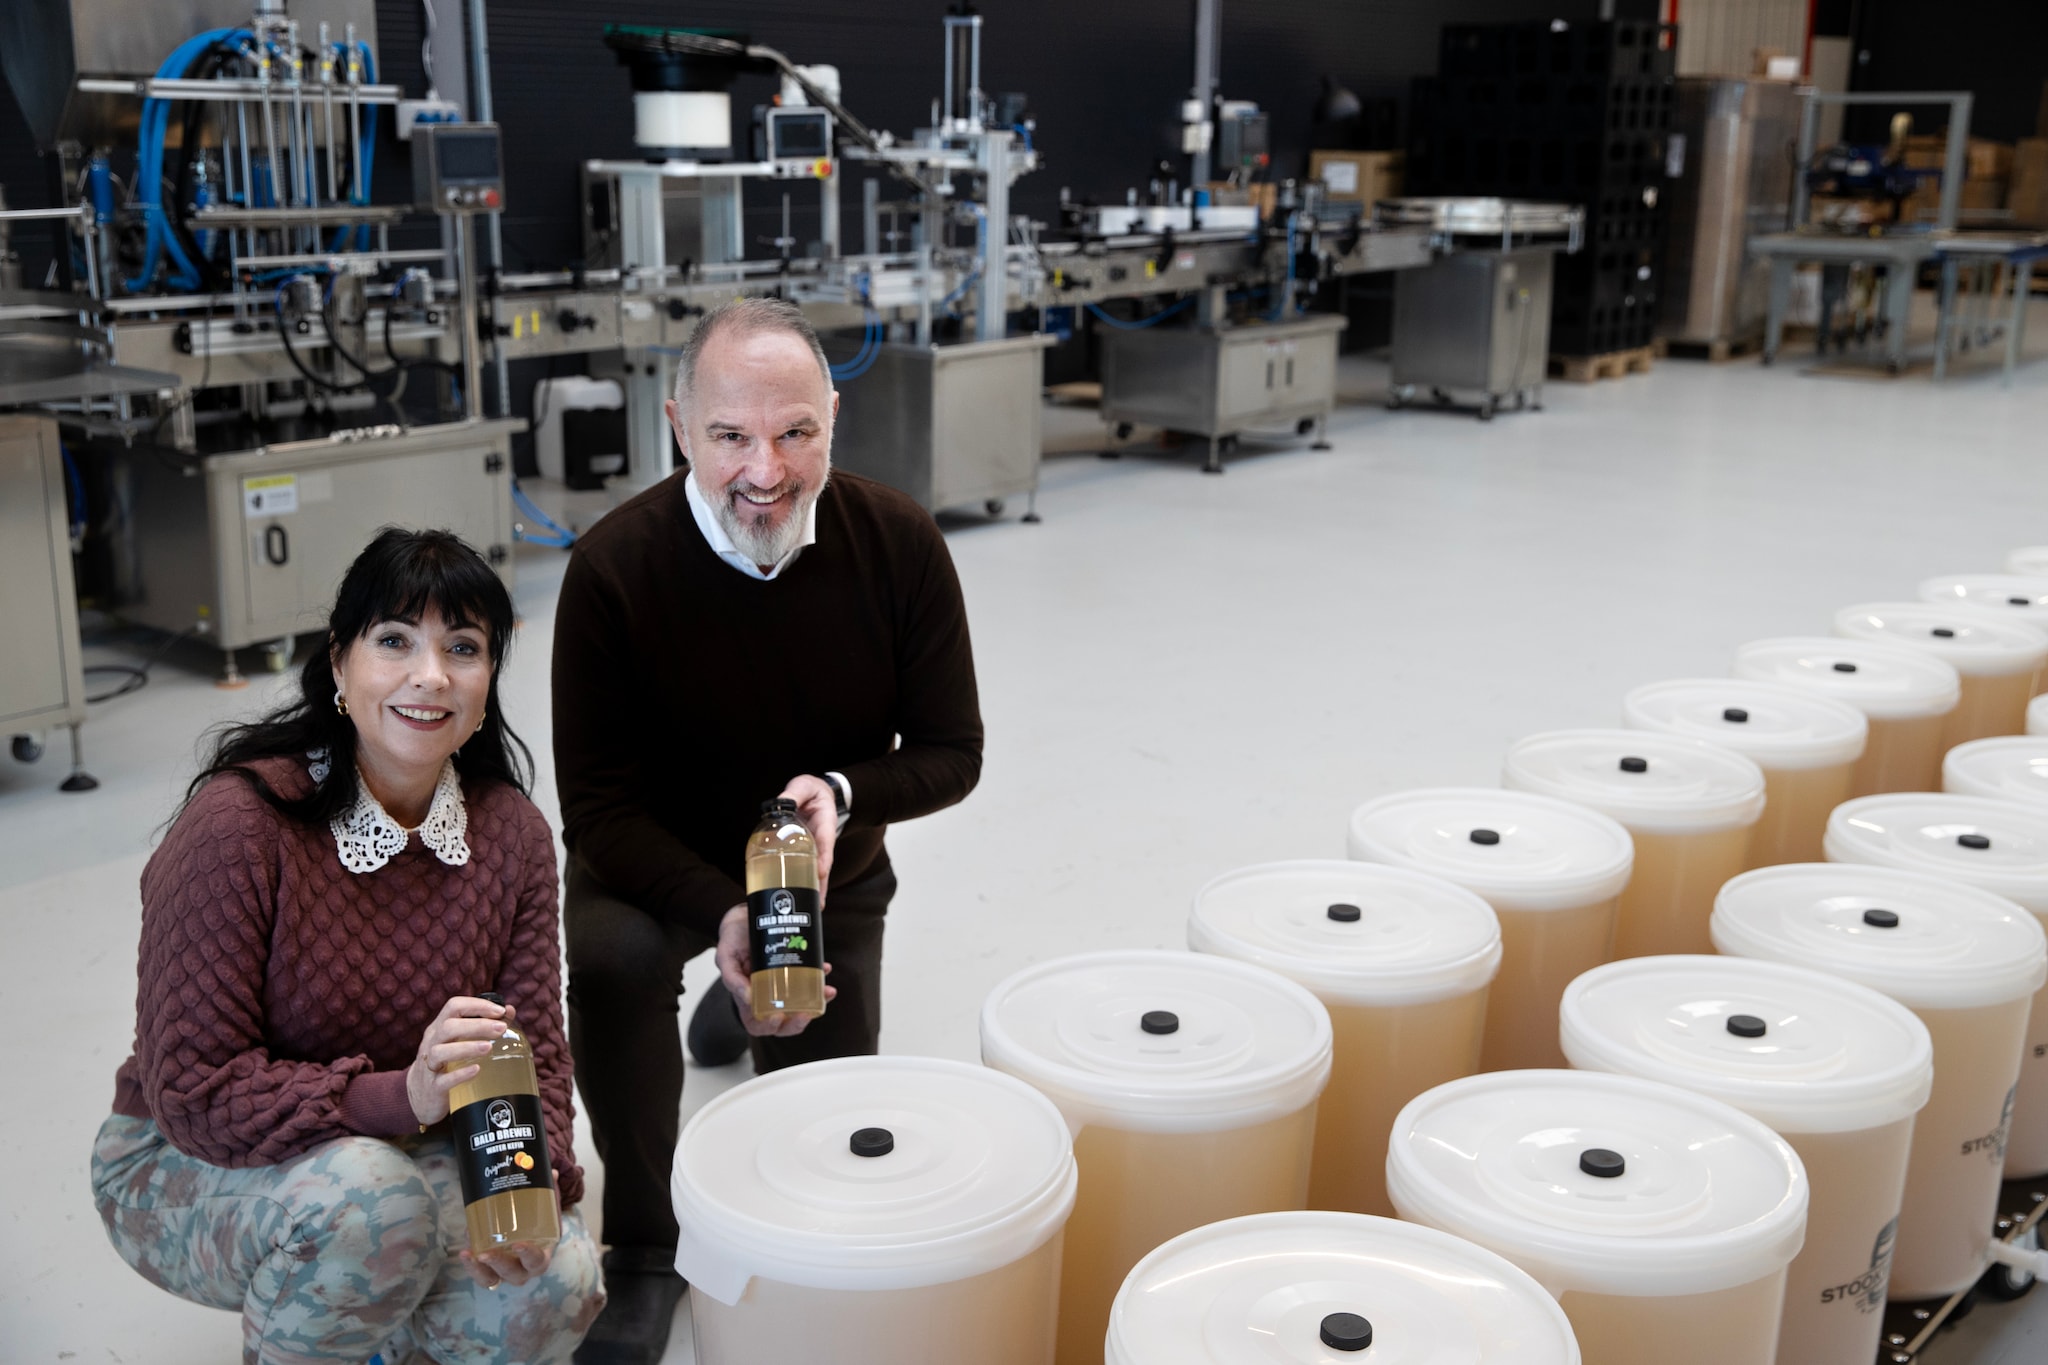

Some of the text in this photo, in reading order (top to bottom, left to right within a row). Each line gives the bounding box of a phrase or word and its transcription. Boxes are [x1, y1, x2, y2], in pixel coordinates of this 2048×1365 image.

[759, 914, 808, 926] BALD BREWER
[767, 927, 785, 935] WATER
[474, 1127, 532, 1147] BALD BREWER
[486, 1141, 525, 1155] WATER KEFIR
